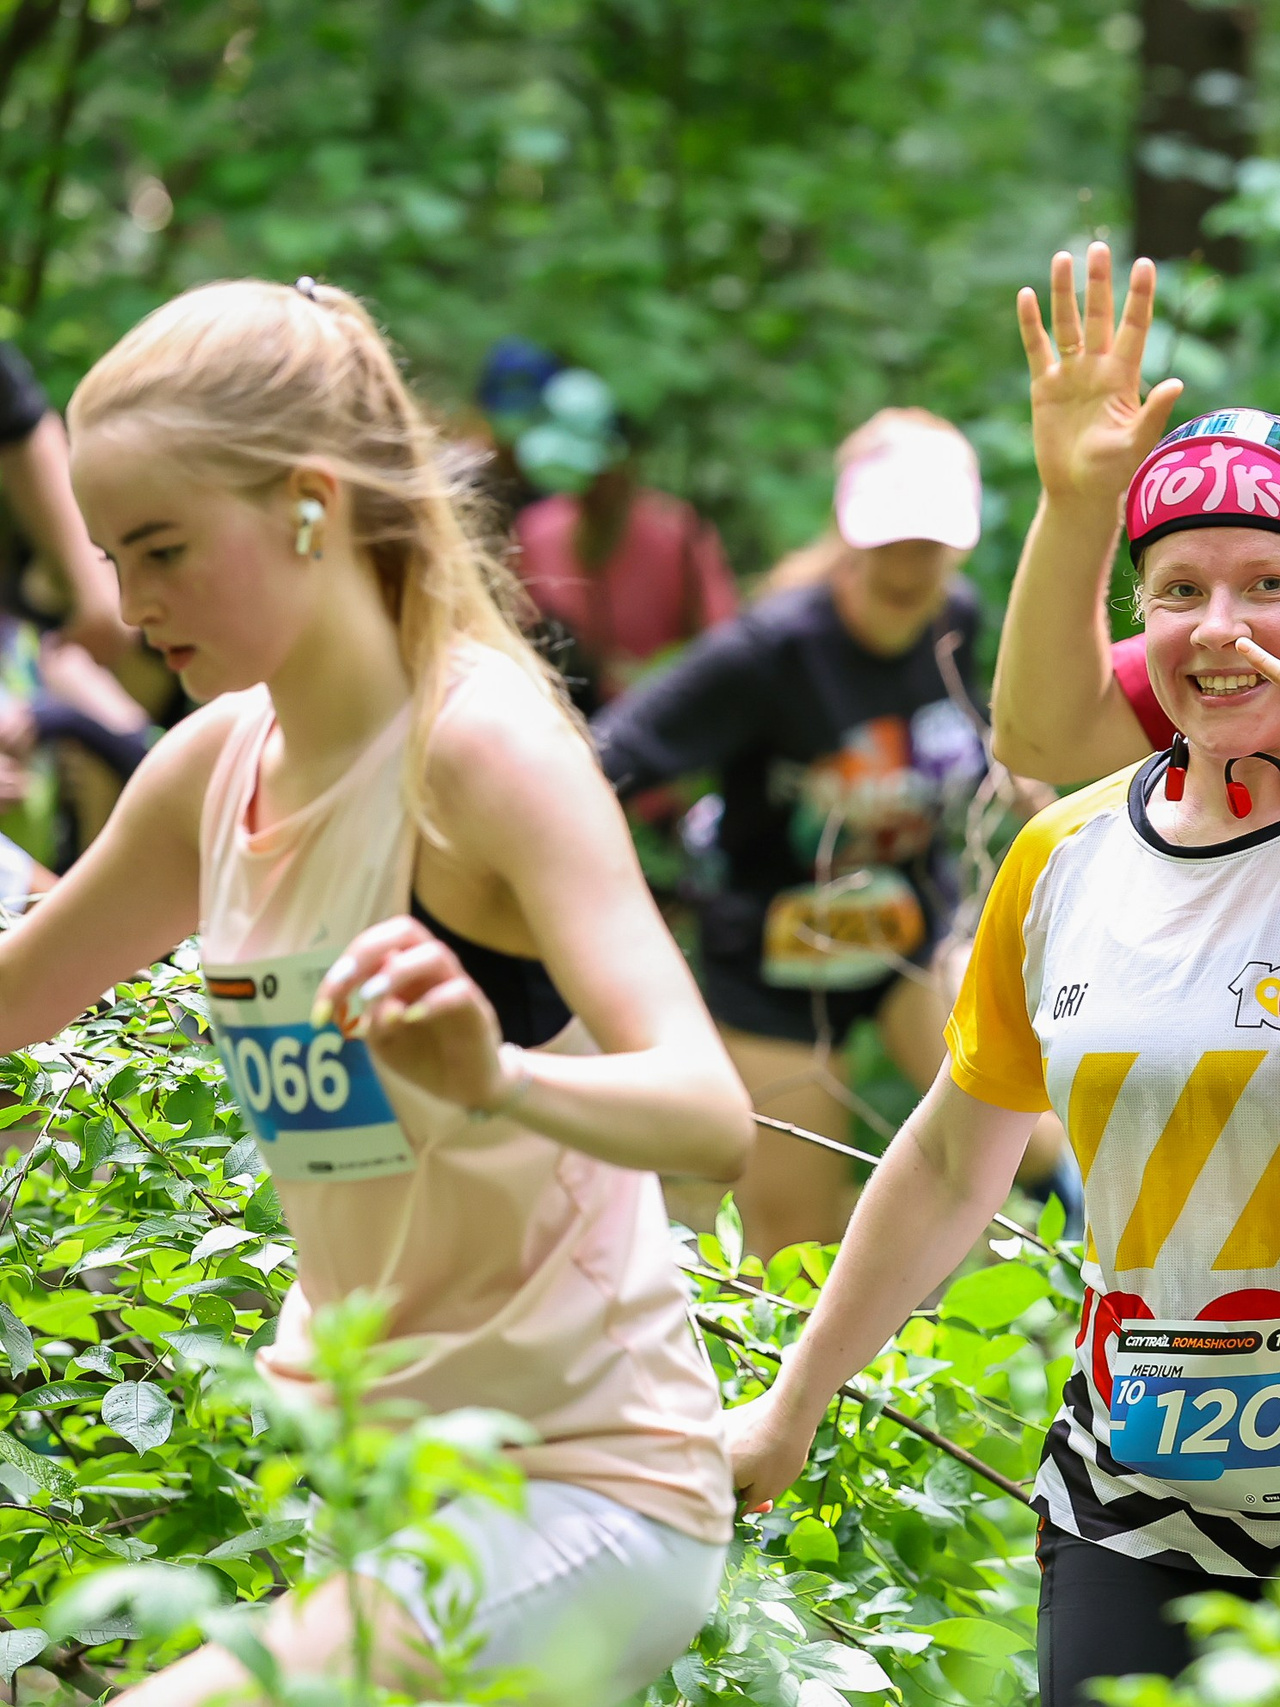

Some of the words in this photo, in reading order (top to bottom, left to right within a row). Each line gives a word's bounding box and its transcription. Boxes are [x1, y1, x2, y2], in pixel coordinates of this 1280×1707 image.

[1172, 1337, 1256, 1349] ROMASHKOVO
[1130, 1364, 1184, 1378] MEDIUM
[1116, 1379, 1146, 1406] 10
